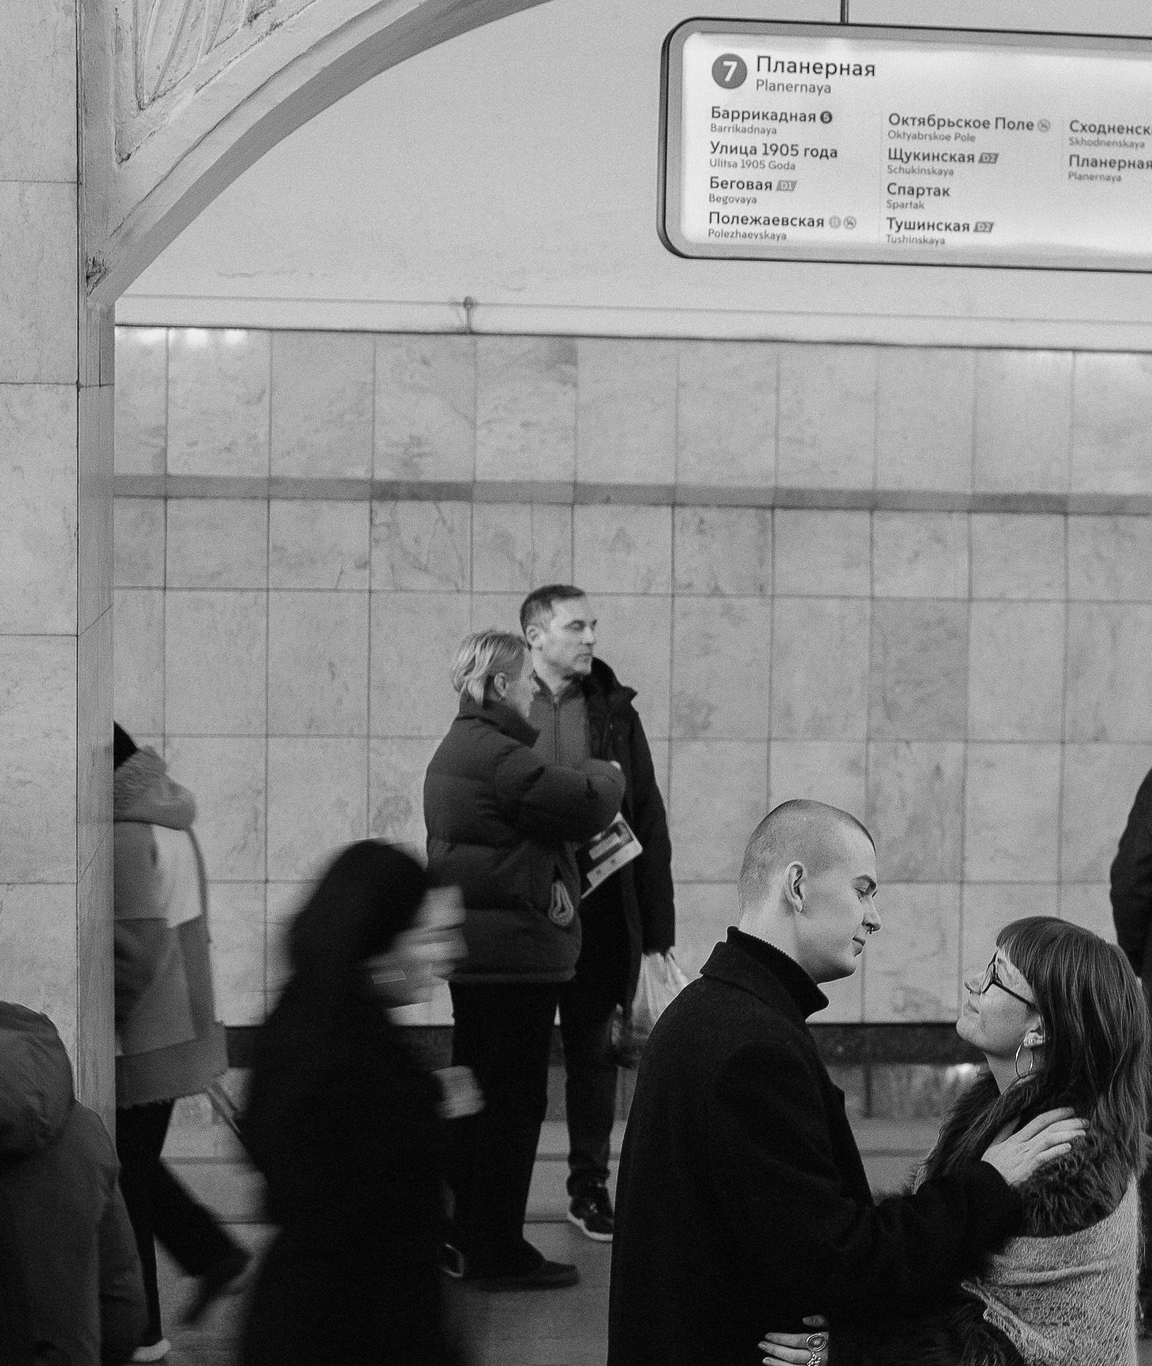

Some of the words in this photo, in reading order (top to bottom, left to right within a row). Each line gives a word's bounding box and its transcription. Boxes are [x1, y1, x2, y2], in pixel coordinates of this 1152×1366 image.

[723, 61, 738, 82] 7
[756, 55, 876, 79] Планерная
[756, 78, 831, 96] Planernaya
[711, 106, 816, 123] Баррикадная
[888, 112, 991, 130] Октябрьское
[994, 117, 1035, 131] Поле
[710, 123, 777, 136] Barrikadnaya
[887, 129, 951, 141] Oktyabrskoe
[954, 132, 976, 142] Pole
[710, 141, 757, 157] Улица
[762, 143, 799, 157] 1905
[804, 147, 838, 160] года
[1068, 137, 1145, 149] Skhodnenskaya
[888, 148, 975, 164] Щукинская
[709, 158, 738, 168] Ulitsa
[741, 159, 766, 169] 1905
[768, 160, 796, 170] Goda
[709, 176, 773, 191] Беговая
[1068, 171, 1122, 183] Planernaya
[887, 182, 950, 198] Спартак
[709, 193, 757, 205] Begovaya
[886, 199, 925, 210] Spartak
[709, 211, 824, 227] Полежаевская
[886, 217, 970, 232] Тушинская
[708, 228, 787, 241] Polezhaevskaya
[886, 234, 945, 247] Tushinskaya
